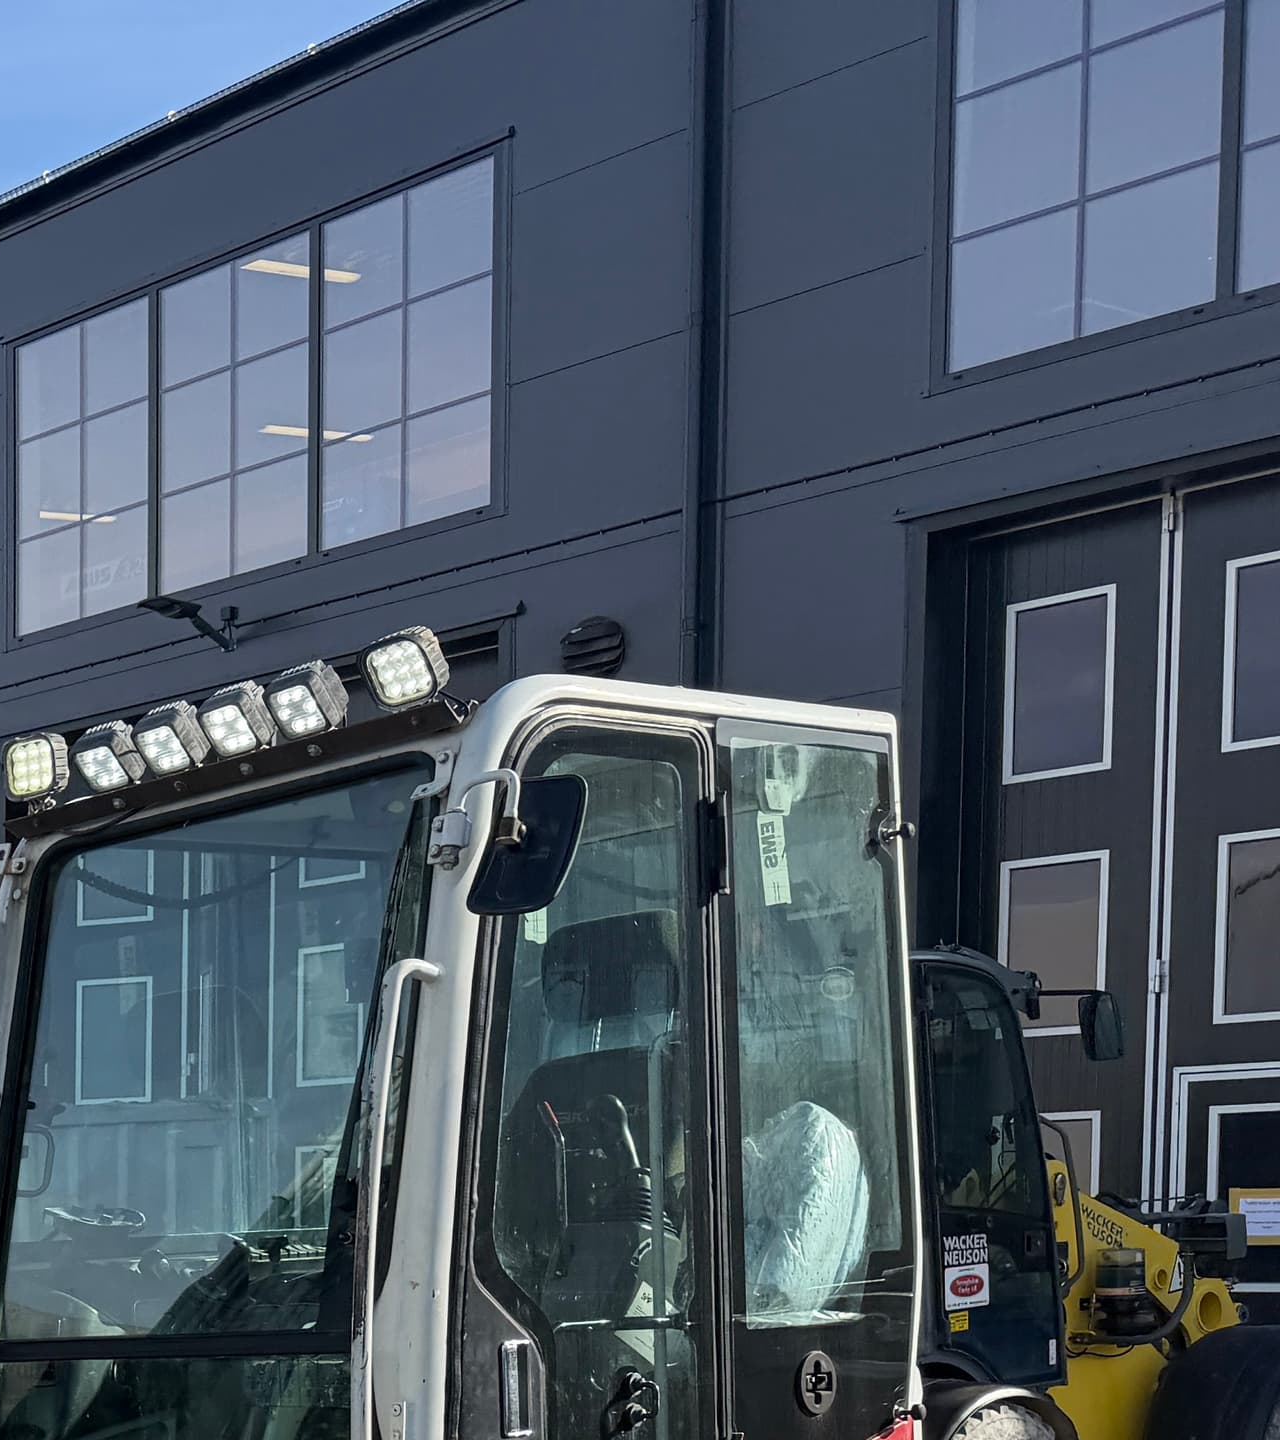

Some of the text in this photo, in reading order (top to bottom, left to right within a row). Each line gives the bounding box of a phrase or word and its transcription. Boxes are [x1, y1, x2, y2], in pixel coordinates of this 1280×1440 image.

[1080, 1203, 1124, 1239] WACKER
[943, 1233, 988, 1251] WACKER
[944, 1247, 989, 1266] NEUSON
